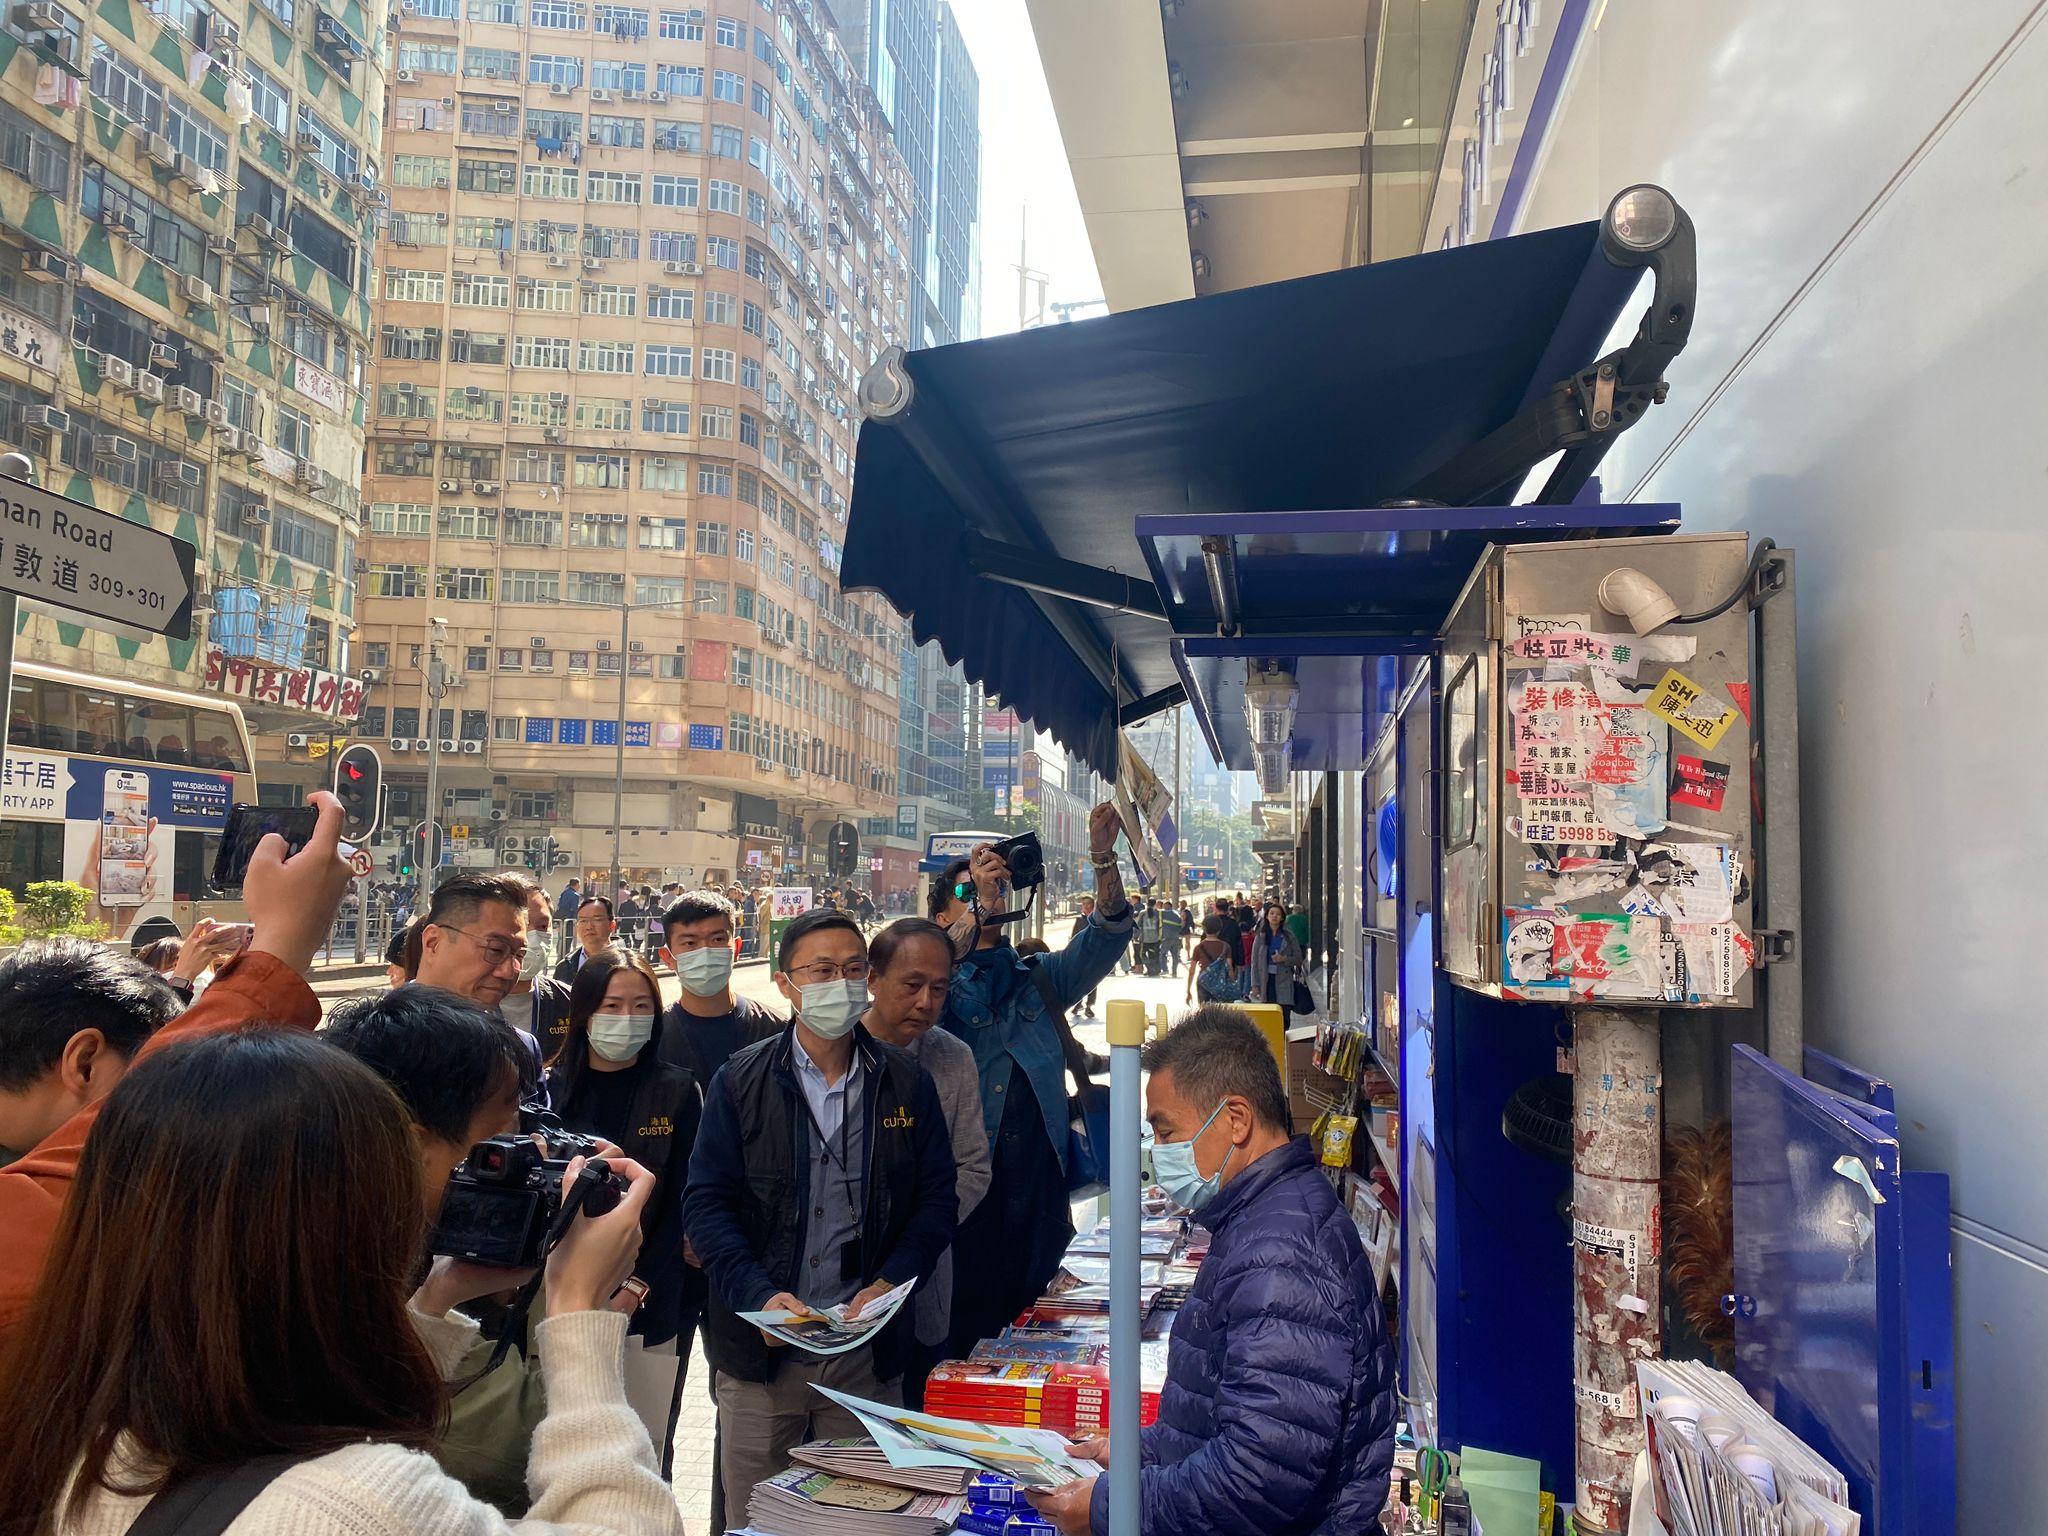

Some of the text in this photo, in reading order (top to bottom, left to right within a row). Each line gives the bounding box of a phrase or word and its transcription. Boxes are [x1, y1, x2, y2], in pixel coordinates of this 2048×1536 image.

[53, 510, 113, 552] Road
[172, 781, 226, 792] www.spacious.hk
[30, 797, 54, 810] APP
[1526, 825, 1555, 840] 旺記
[1559, 827, 1593, 840] 5998
